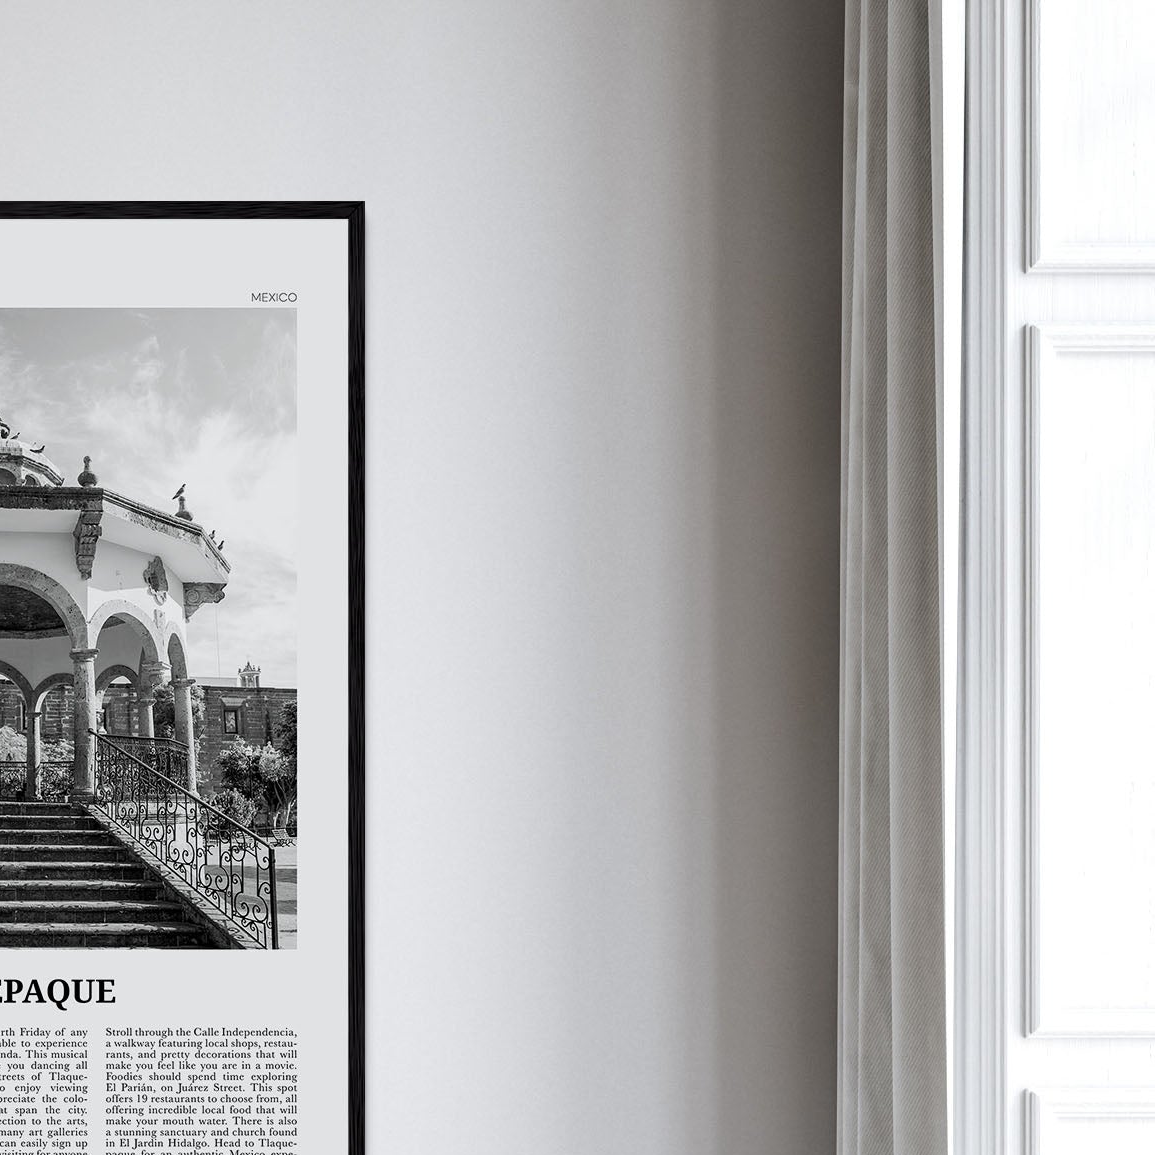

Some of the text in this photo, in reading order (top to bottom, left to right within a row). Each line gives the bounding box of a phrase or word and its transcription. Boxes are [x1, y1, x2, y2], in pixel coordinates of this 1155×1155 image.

[250, 292, 298, 303] MEXICO
[20, 1028, 51, 1039] Friday
[54, 1028, 65, 1037] of
[70, 1030, 88, 1039] any
[105, 1028, 298, 1039] Stroll through the Calle Independencia,
[26, 1050, 48, 1059] This
[51, 1050, 88, 1059] musical
[106, 1050, 298, 1061] rants, and pretty decorations that will
[31, 1072, 42, 1081] of
[50, 1072, 88, 1083] Tlaque-
[106, 1072, 298, 1083] Foodies should spend time exploring
[14, 1083, 42, 1094] enjoy
[50, 1083, 88, 1094] viewing
[42, 1094, 58, 1103] the
[63, 1094, 88, 1103] colo-
[105, 1094, 298, 1105] offers 19 restaurants to choose from, all
[31, 1116, 42, 1125] to
[46, 1116, 62, 1125] the
[66, 1116, 88, 1127] arts,
[105, 1116, 298, 1127] make your mouth water. There is also
[20, 1139, 48, 1150] easily
[51, 1139, 71, 1150] sign
[75, 1141, 88, 1150] up
[105, 1139, 115, 1148] in
[119, 1139, 130, 1148] El
[168, 1139, 210, 1150] Hidalgo.
[214, 1139, 241, 1148] Head
[244, 1139, 255, 1148] to
[259, 1139, 298, 1150] Tlaque-
